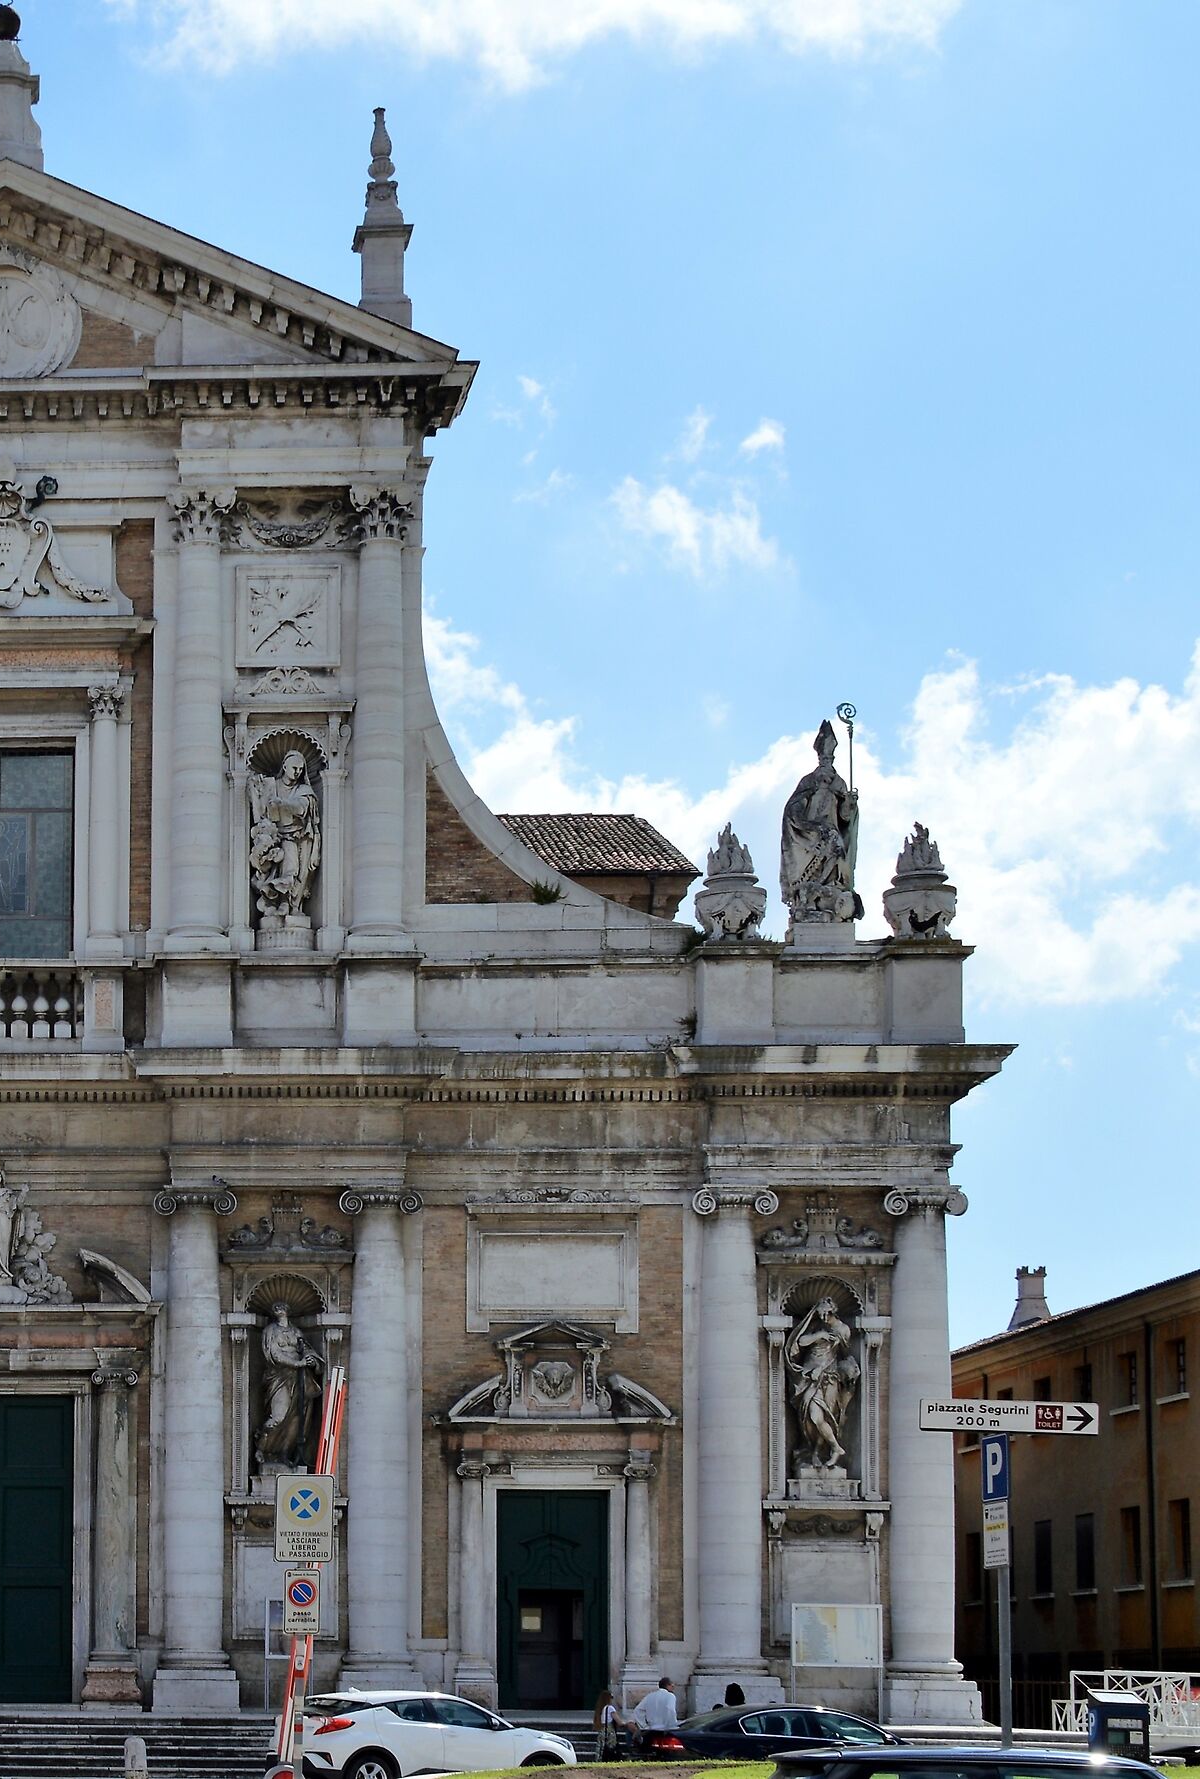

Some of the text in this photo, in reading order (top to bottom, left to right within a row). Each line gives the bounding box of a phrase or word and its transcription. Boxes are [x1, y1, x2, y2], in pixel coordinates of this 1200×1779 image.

[927, 1403, 1029, 1416] piazzale Segurini
[956, 1416, 1000, 1427] 200 m
[986, 1442, 1003, 1494] P
